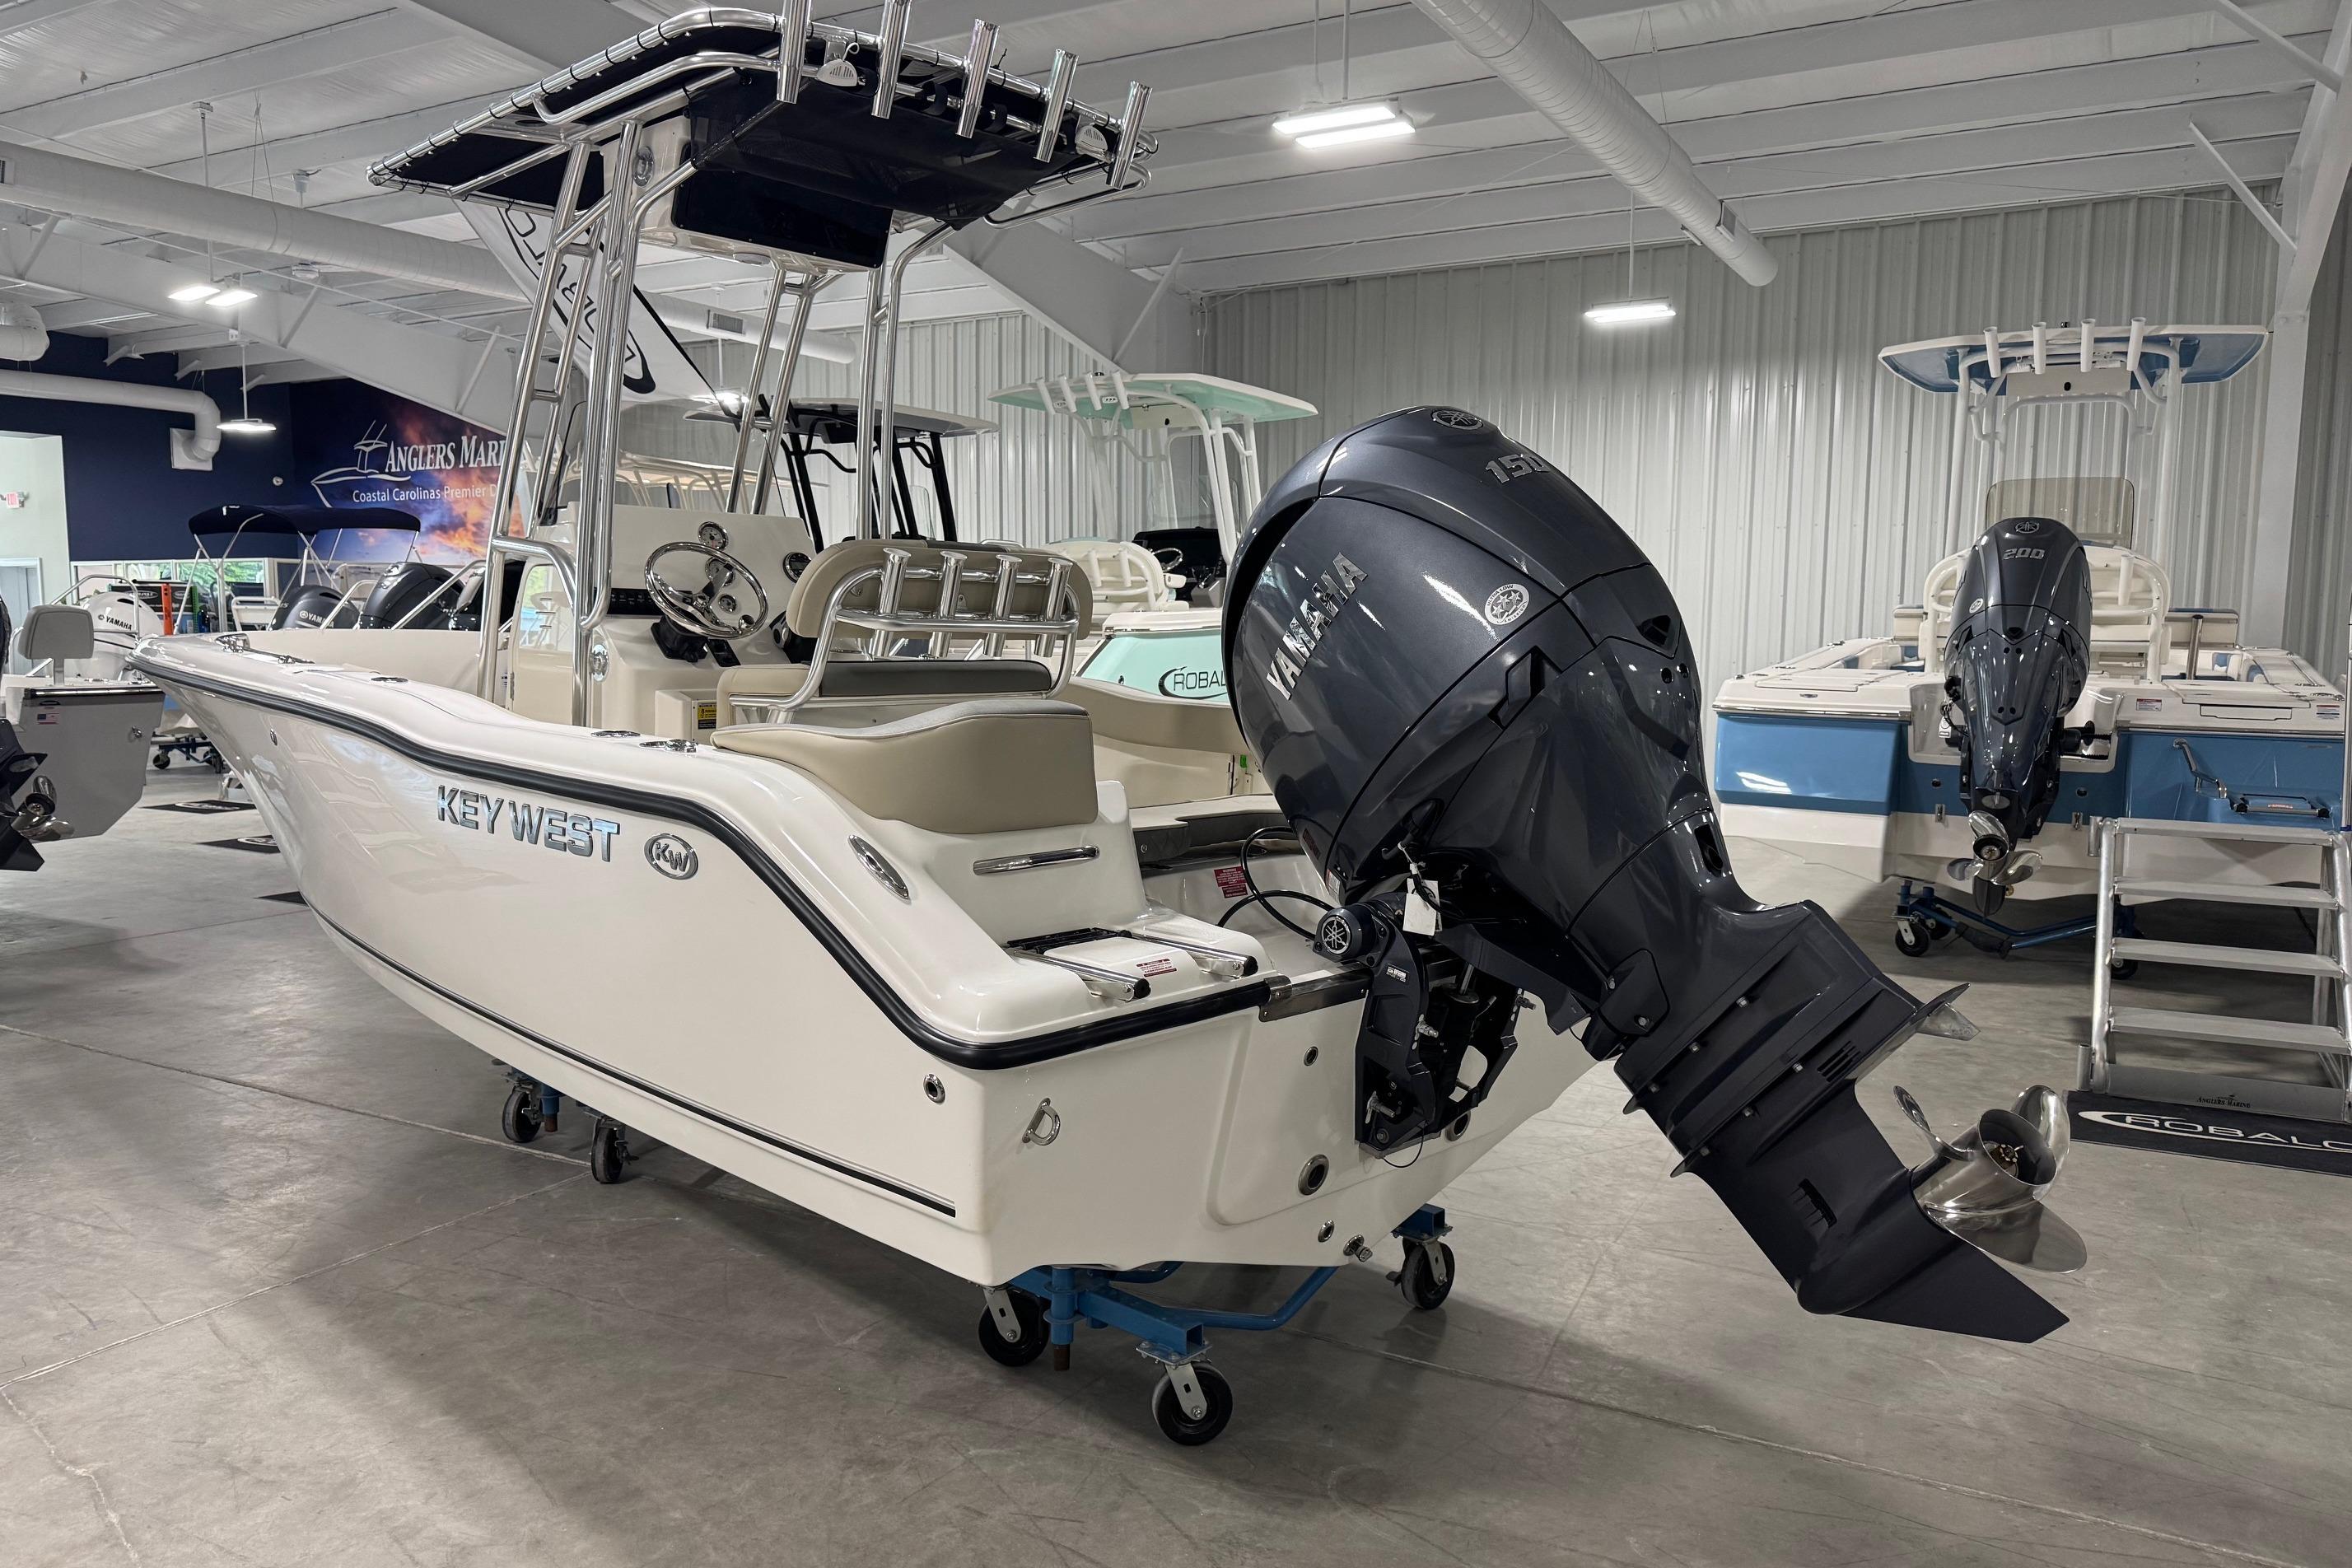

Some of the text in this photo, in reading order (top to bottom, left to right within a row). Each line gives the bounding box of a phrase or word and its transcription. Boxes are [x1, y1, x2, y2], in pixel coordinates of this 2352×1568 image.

[385, 436, 505, 472] ANGLERS MARI
[1486, 454, 1550, 483] 150
[352, 488, 390, 502] Coastal
[393, 487, 441, 501] Carolinas
[444, 484, 486, 498] Premier
[2004, 548, 2046, 560] 200
[106, 616, 132, 630] YAMAHA
[1266, 552, 1368, 700] YAMAHA
[1174, 670, 1227, 691] ROBAL
[437, 785, 620, 862] KEY WEST
[655, 842, 688, 872] KW
